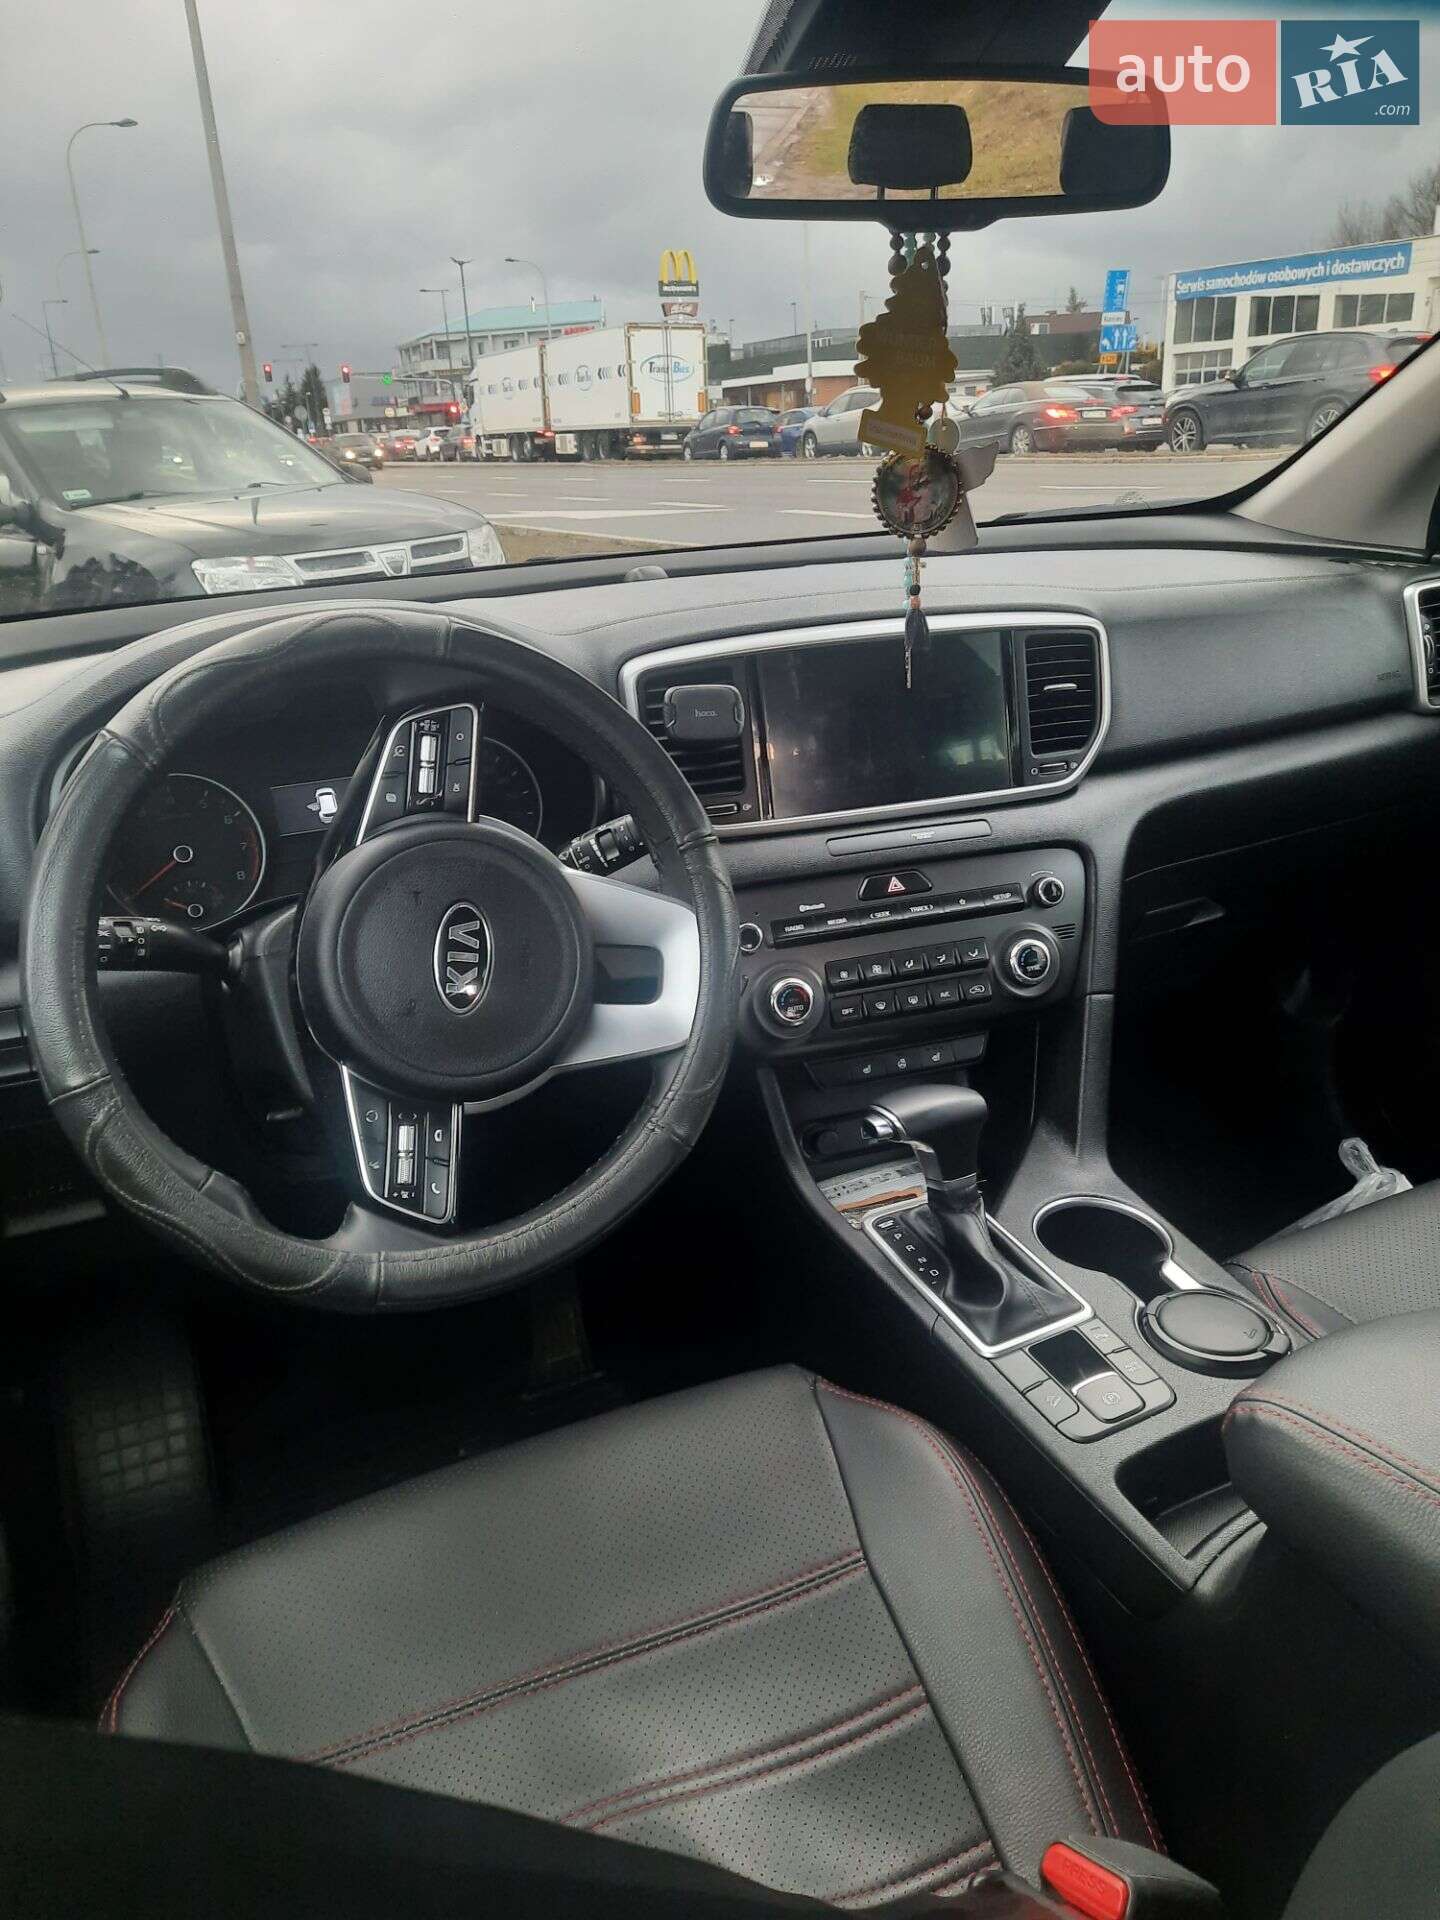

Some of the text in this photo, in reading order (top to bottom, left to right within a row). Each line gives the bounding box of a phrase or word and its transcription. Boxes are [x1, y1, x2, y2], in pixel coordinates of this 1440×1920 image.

[1177, 251, 1405, 293] Serwis samochodów osobowych i dostawczych
[446, 920, 480, 995] KIA
[787, 1004, 804, 1014] AUTO
